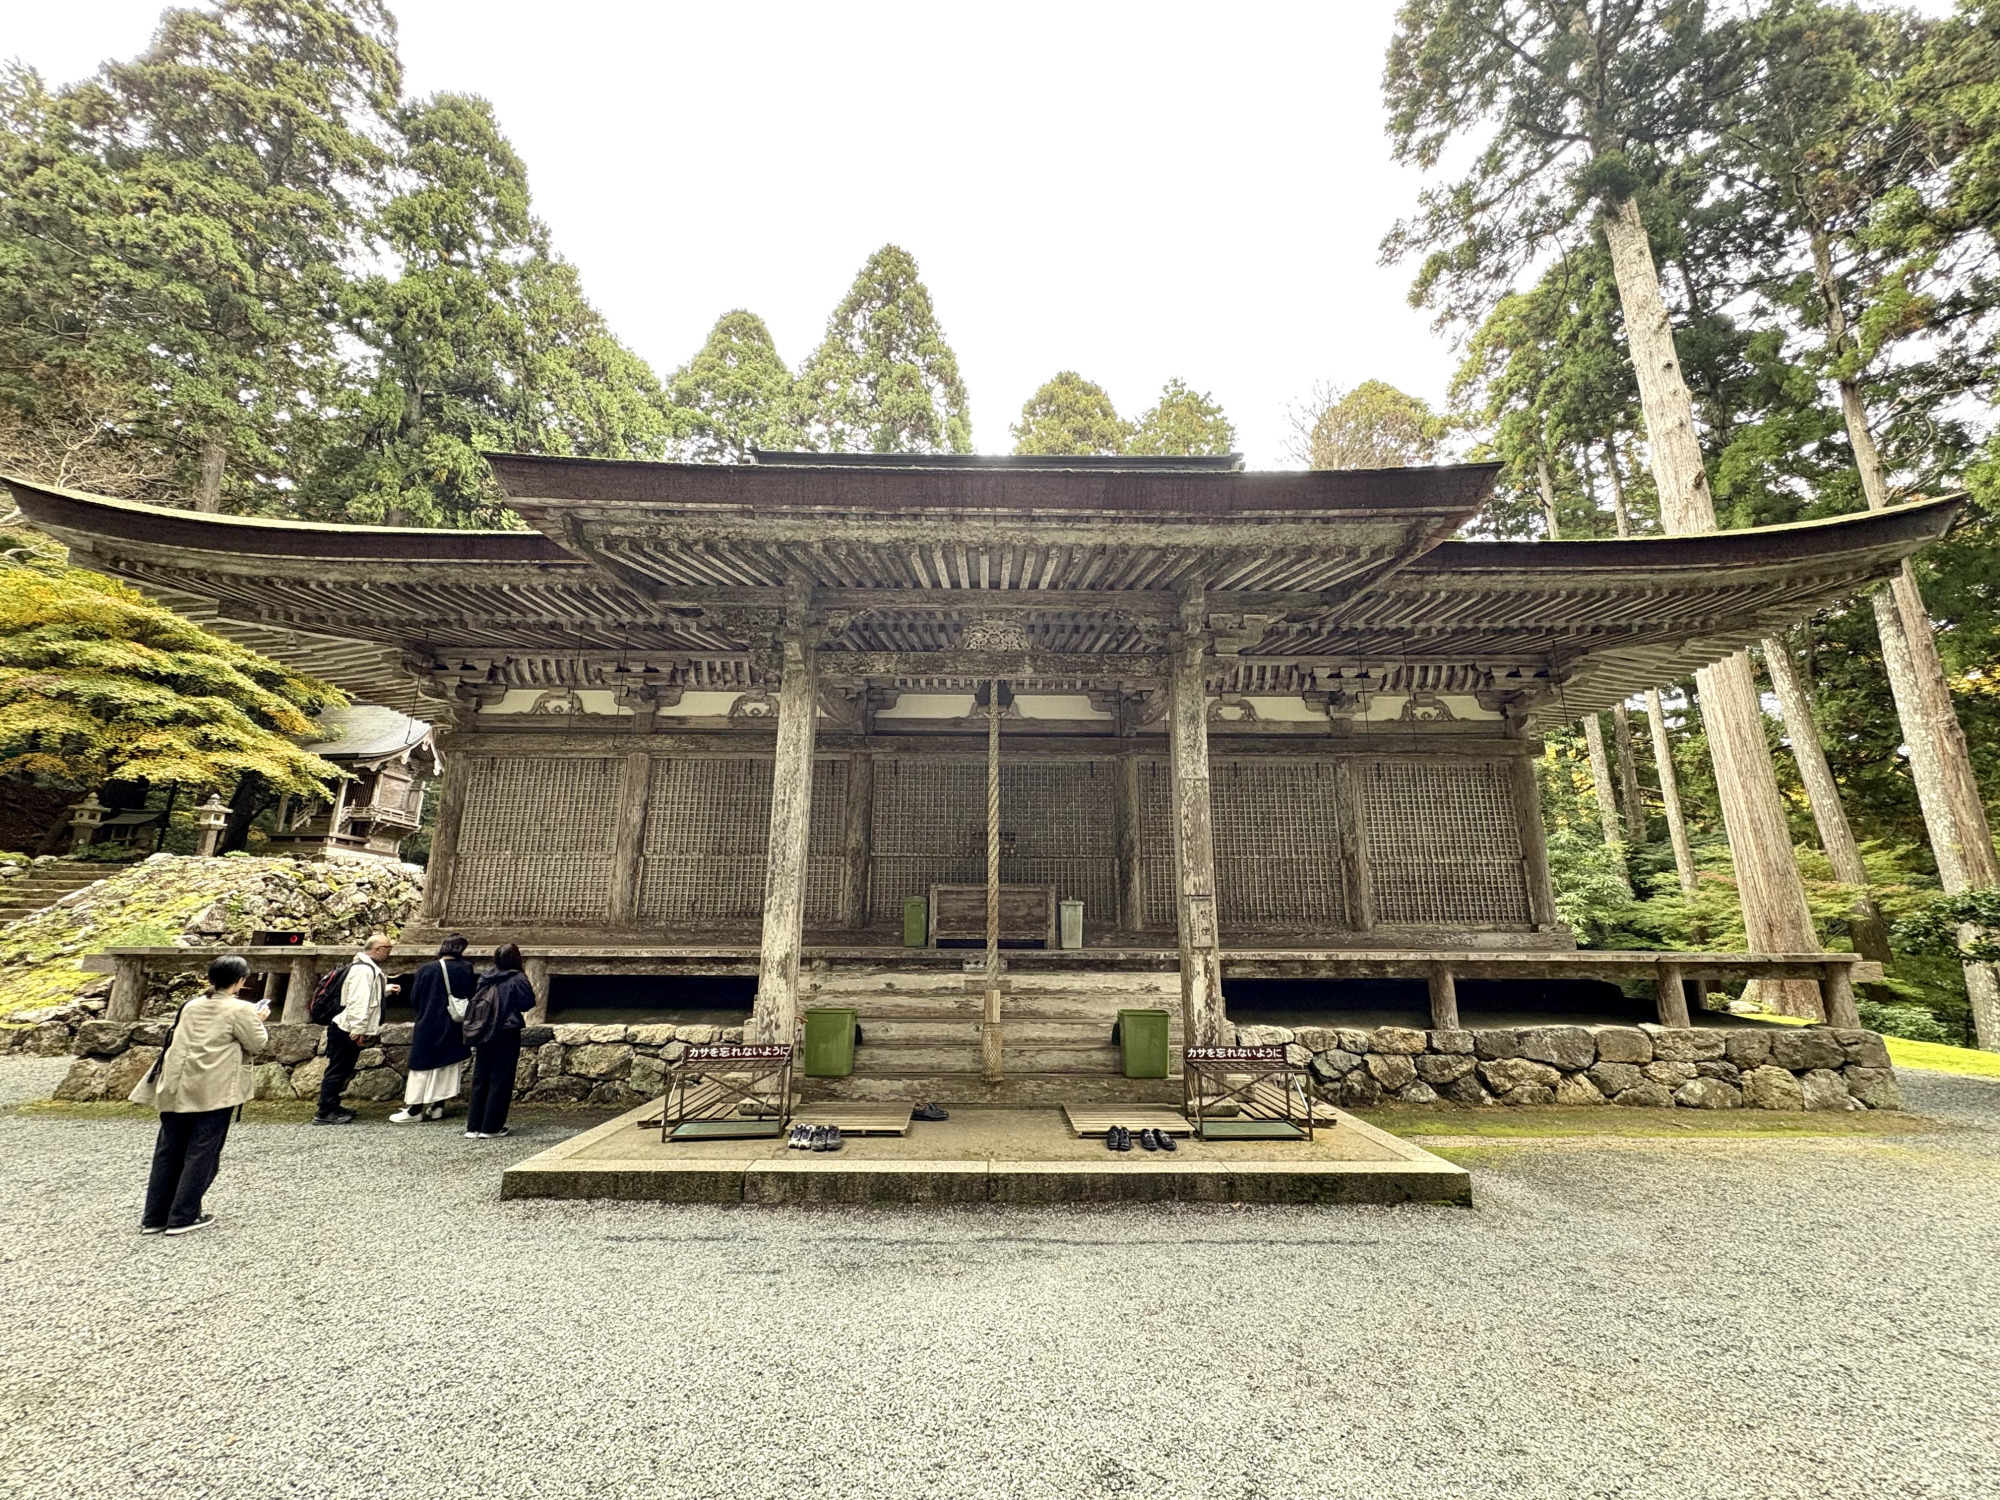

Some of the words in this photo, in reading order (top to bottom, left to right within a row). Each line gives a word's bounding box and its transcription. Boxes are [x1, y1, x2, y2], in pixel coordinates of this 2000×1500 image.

[689, 1046, 790, 1057] カサを忘れないように
[1187, 1048, 1282, 1058] カサを忘れないように
